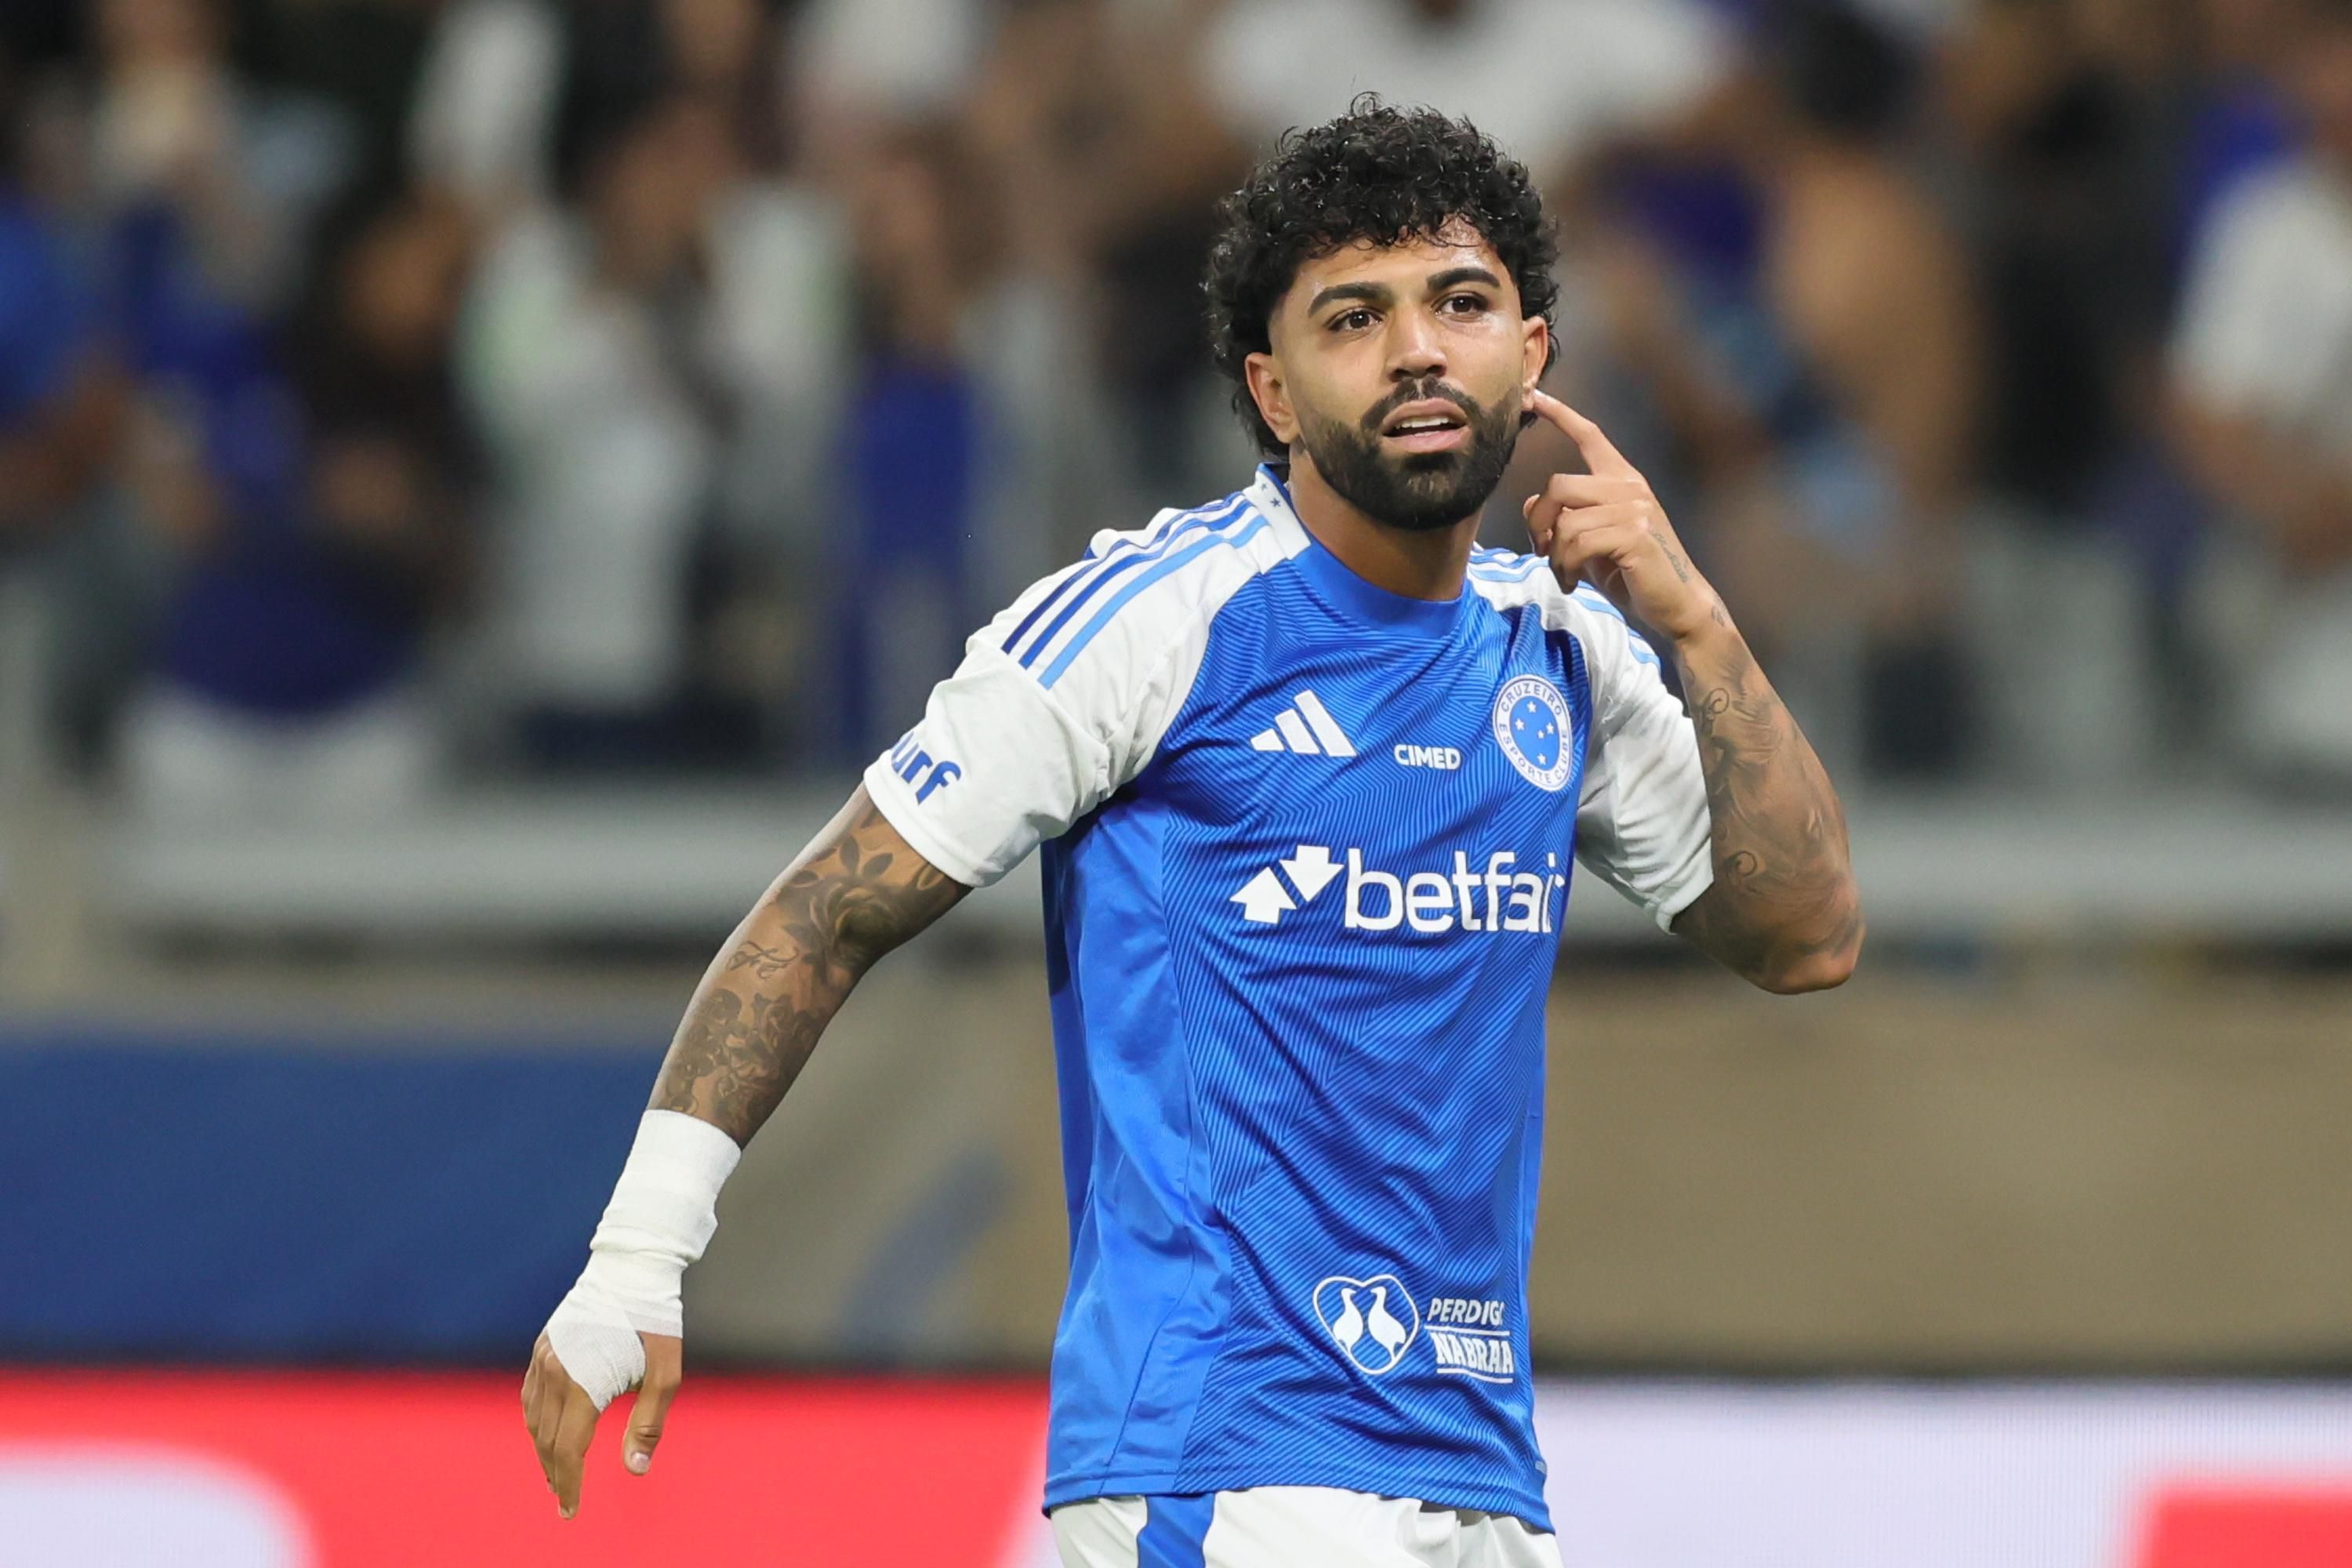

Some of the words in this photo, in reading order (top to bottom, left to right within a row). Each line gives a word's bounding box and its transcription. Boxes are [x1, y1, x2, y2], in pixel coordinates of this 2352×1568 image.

[1501, 683, 1563, 717] CRUZEIRO
[1394, 744, 1461, 770] CIMED
[1499, 723, 1553, 783] ESPORTE
